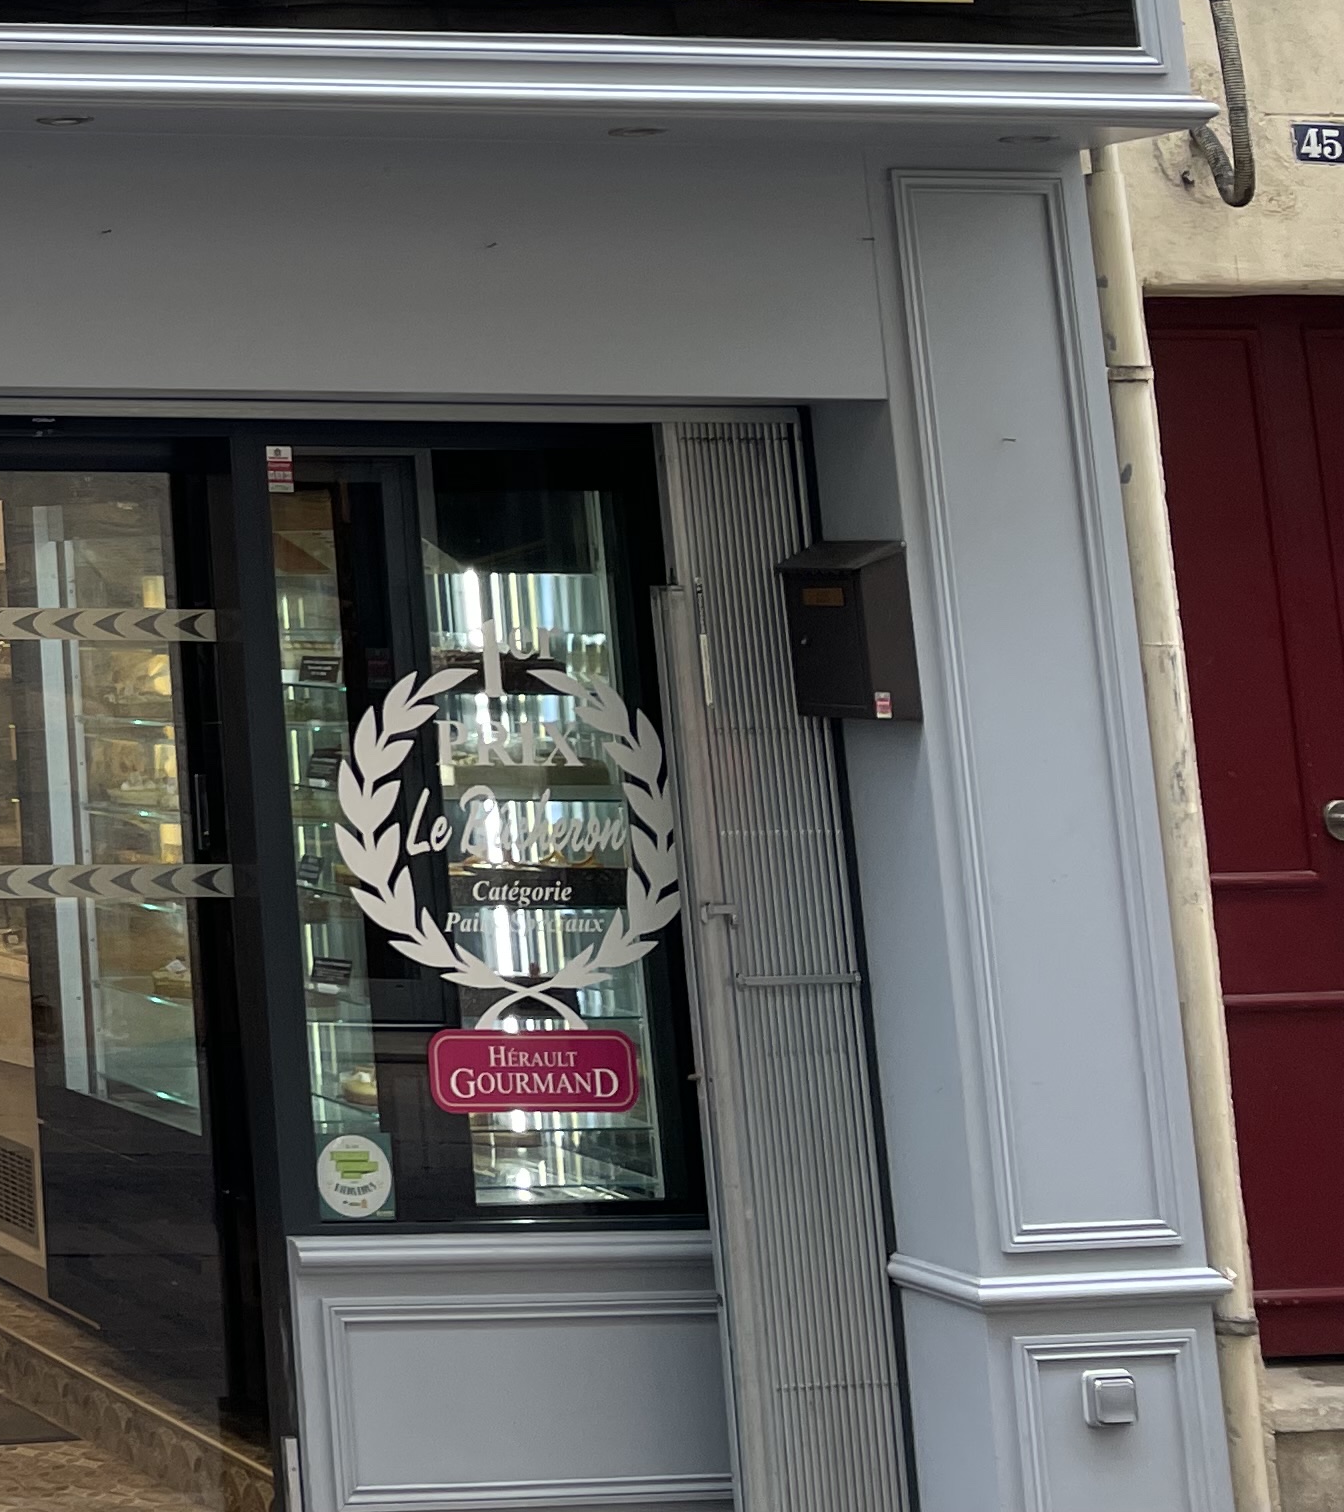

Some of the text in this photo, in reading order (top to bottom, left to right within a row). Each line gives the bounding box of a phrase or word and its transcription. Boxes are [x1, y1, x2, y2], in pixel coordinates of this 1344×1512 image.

[1300, 128, 1344, 160] 45
[433, 719, 585, 767] PRIX
[406, 787, 453, 856] Le
[472, 880, 573, 908] Catégorie
[488, 1045, 578, 1068] HÉRAULT
[450, 1067, 619, 1099] GOURMAND
